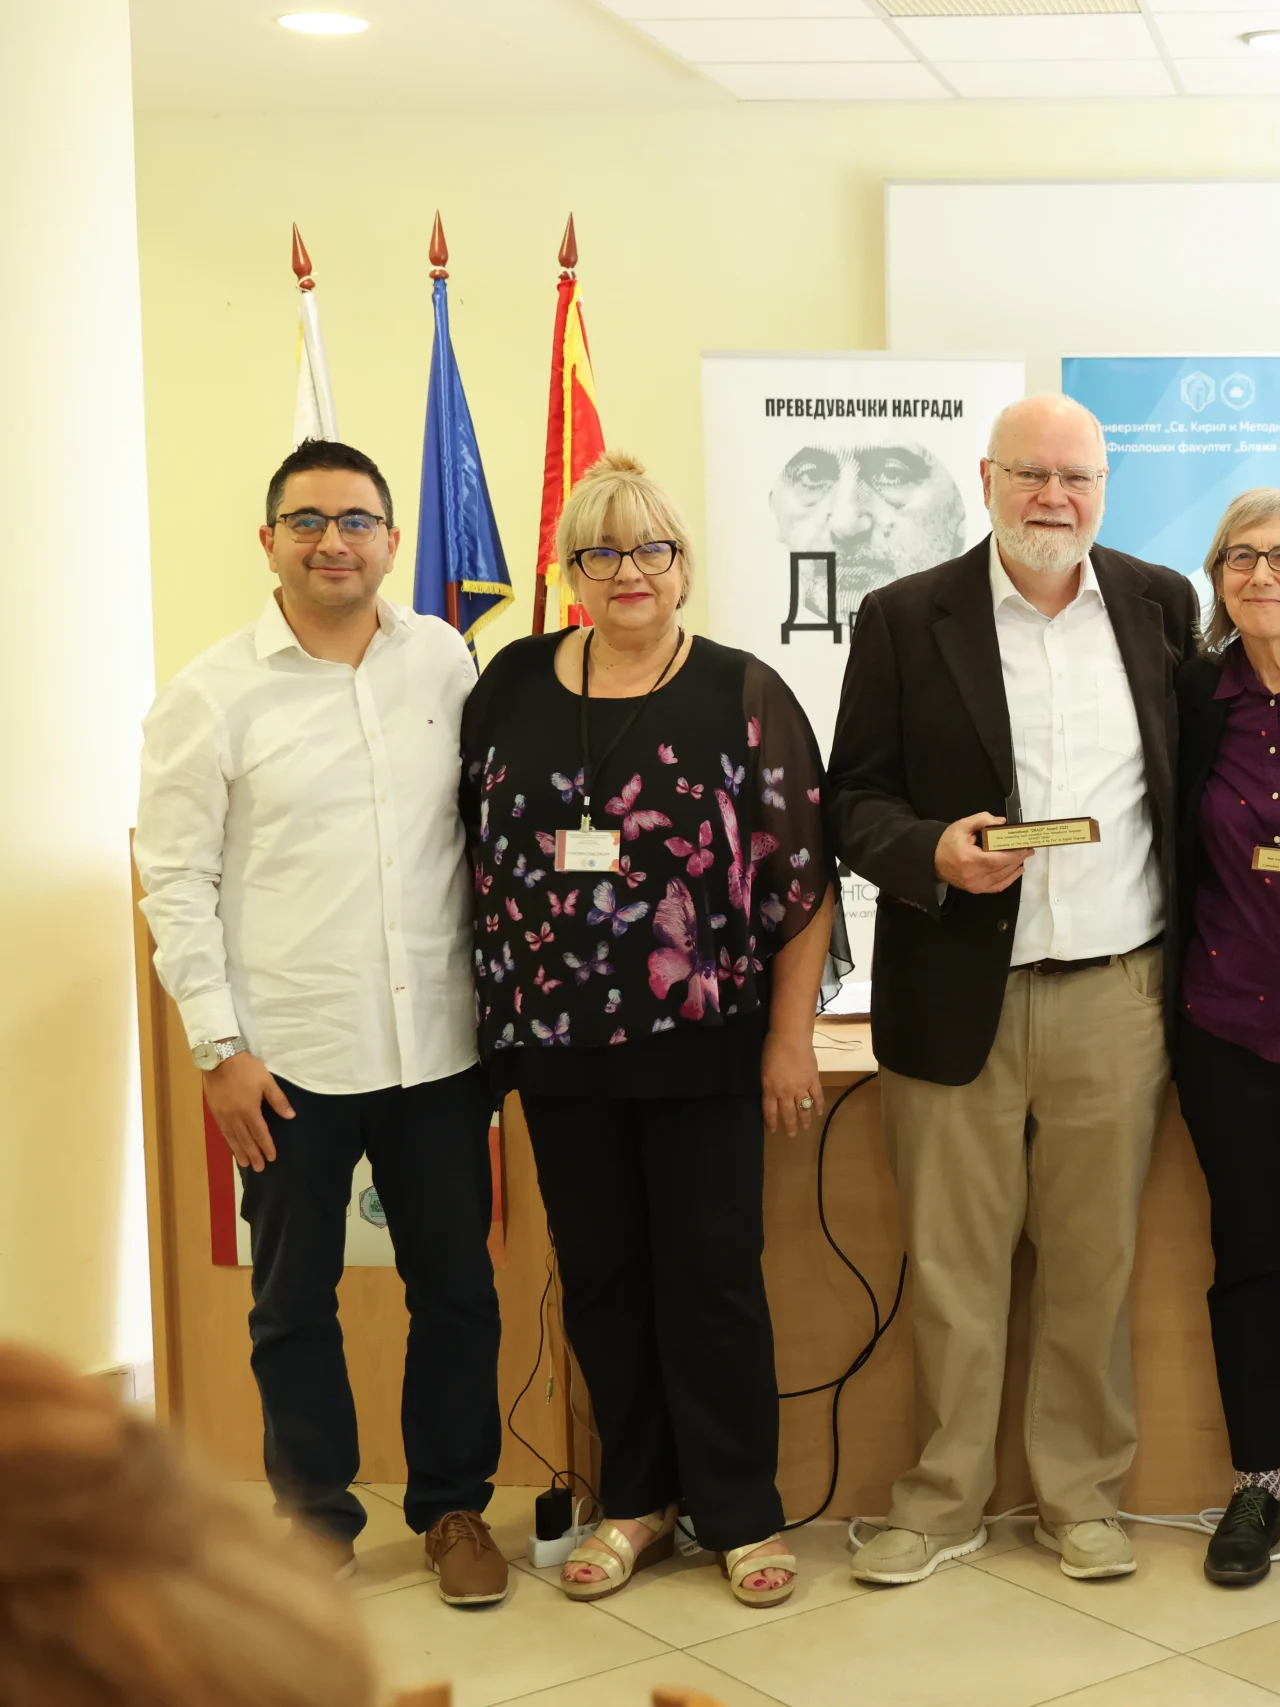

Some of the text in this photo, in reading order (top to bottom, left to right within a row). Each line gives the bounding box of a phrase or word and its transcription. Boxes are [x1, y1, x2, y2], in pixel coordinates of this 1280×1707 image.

[765, 398, 963, 421] ПРЕВЕДУВАЧКИ НАГРАДИ
[1190, 421, 1227, 435] Кирил
[1229, 423, 1237, 433] и
[1106, 441, 1176, 453] Филолошки
[1178, 440, 1233, 455] факултет
[842, 884, 879, 901] НТО
